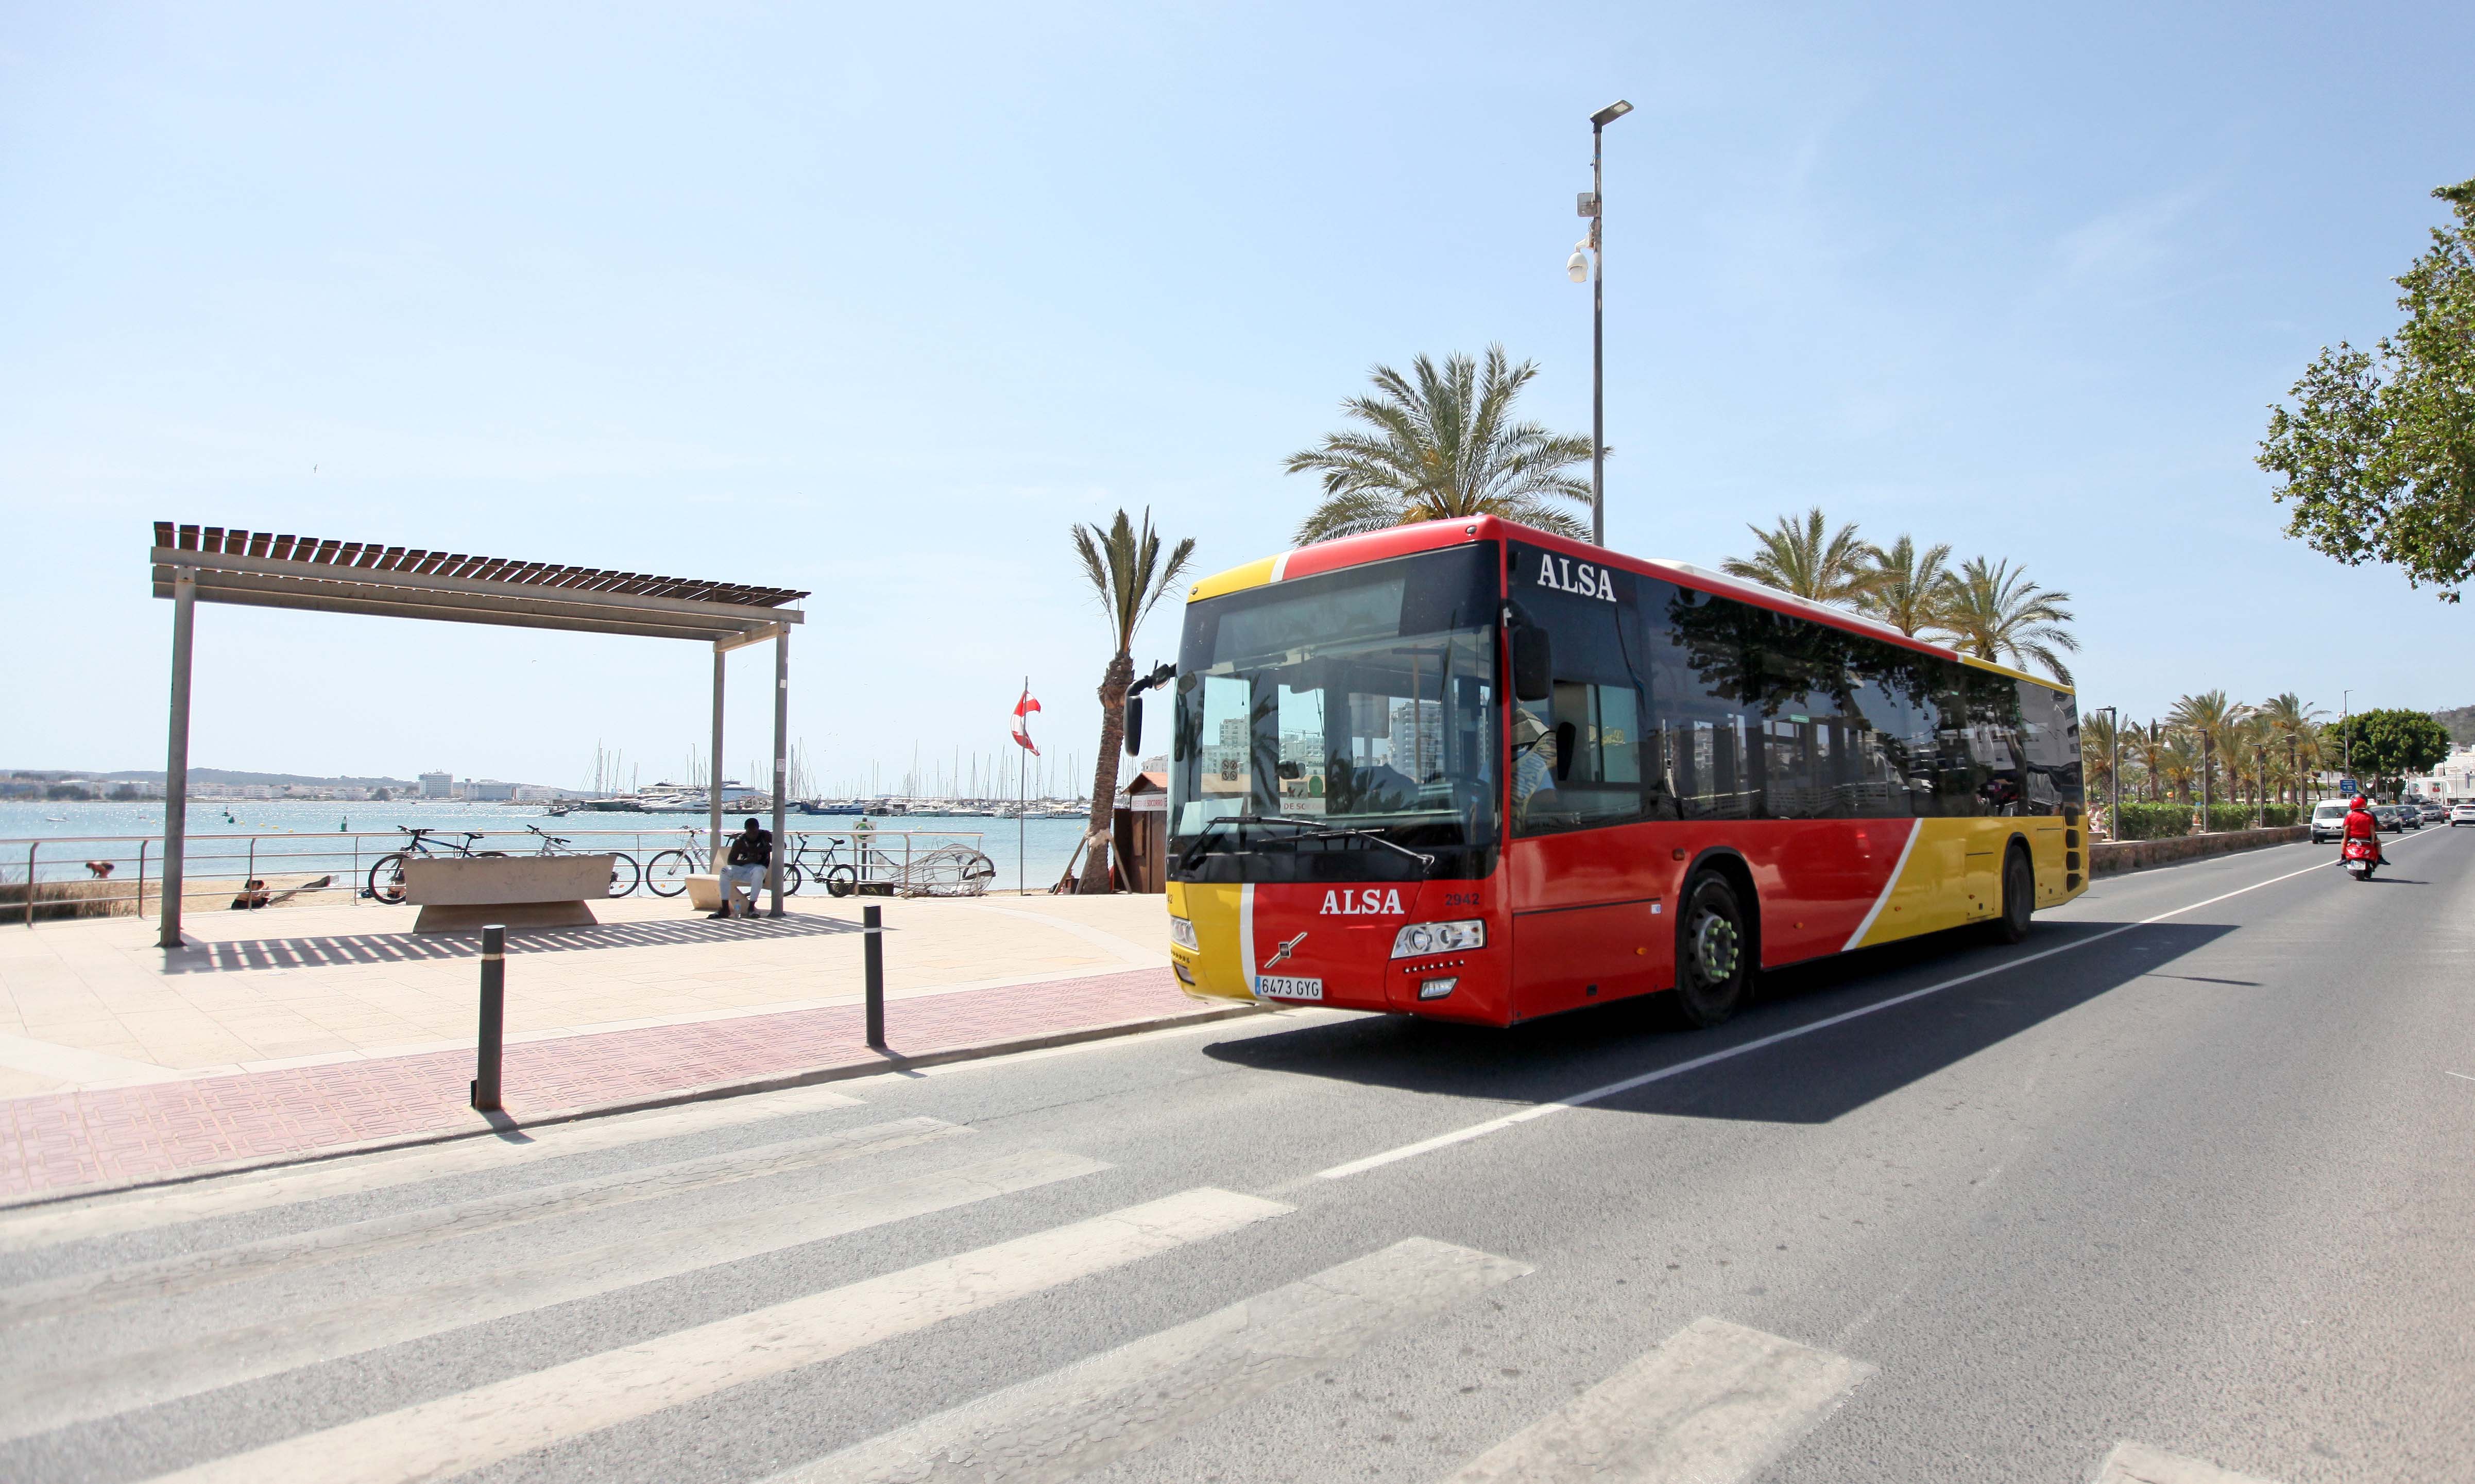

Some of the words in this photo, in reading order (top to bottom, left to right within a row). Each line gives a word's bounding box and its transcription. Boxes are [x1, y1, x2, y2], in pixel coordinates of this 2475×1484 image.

[1537, 554, 1617, 602] ALSA
[1147, 799, 1163, 807] SOCORRO
[1320, 889, 1405, 914] ALSA
[1445, 892, 1479, 906] 2942
[1262, 979, 1291, 994] 6473
[1297, 981, 1319, 996] GYG
